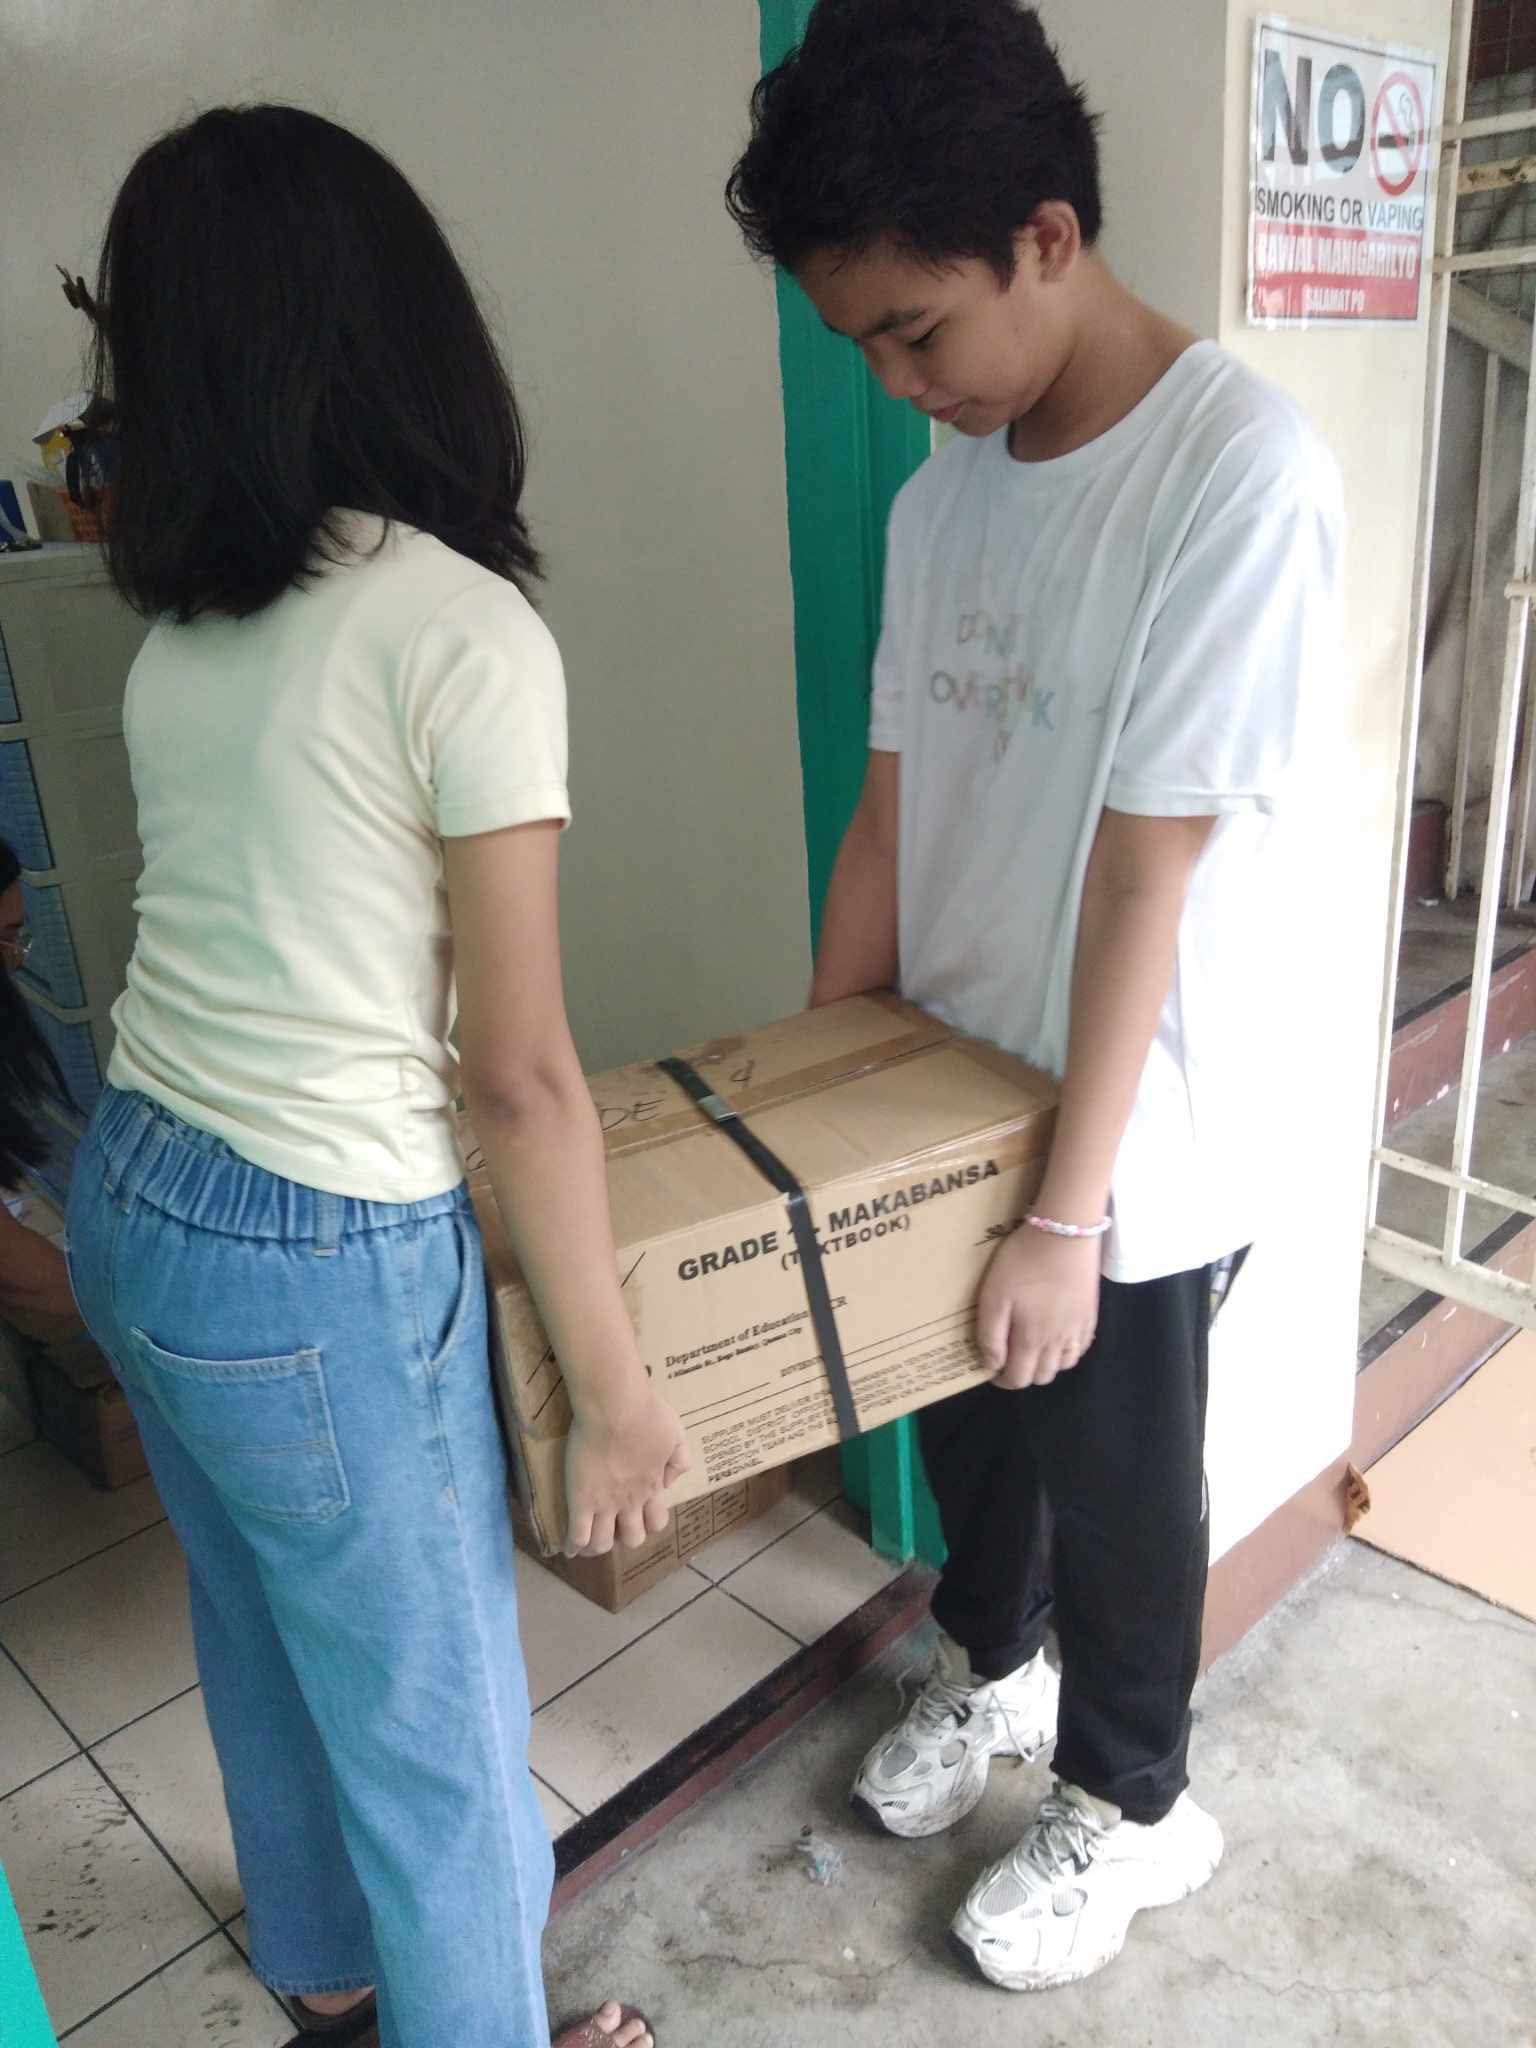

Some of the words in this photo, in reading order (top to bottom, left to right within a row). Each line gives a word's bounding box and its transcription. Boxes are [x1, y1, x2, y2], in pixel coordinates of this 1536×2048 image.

[1261, 48, 1366, 174] NO
[1256, 188, 1335, 222] SMOKING
[1340, 198, 1362, 225] OR
[1367, 203, 1423, 231] VAPING
[678, 1231, 779, 1281] GRADE
[829, 1159, 999, 1233] MAKABANSA
[781, 1214, 910, 1271] (TXTBOOK)
[664, 1334, 736, 1368] Department
[737, 1328, 751, 1341] of
[751, 1309, 808, 1336] Education
